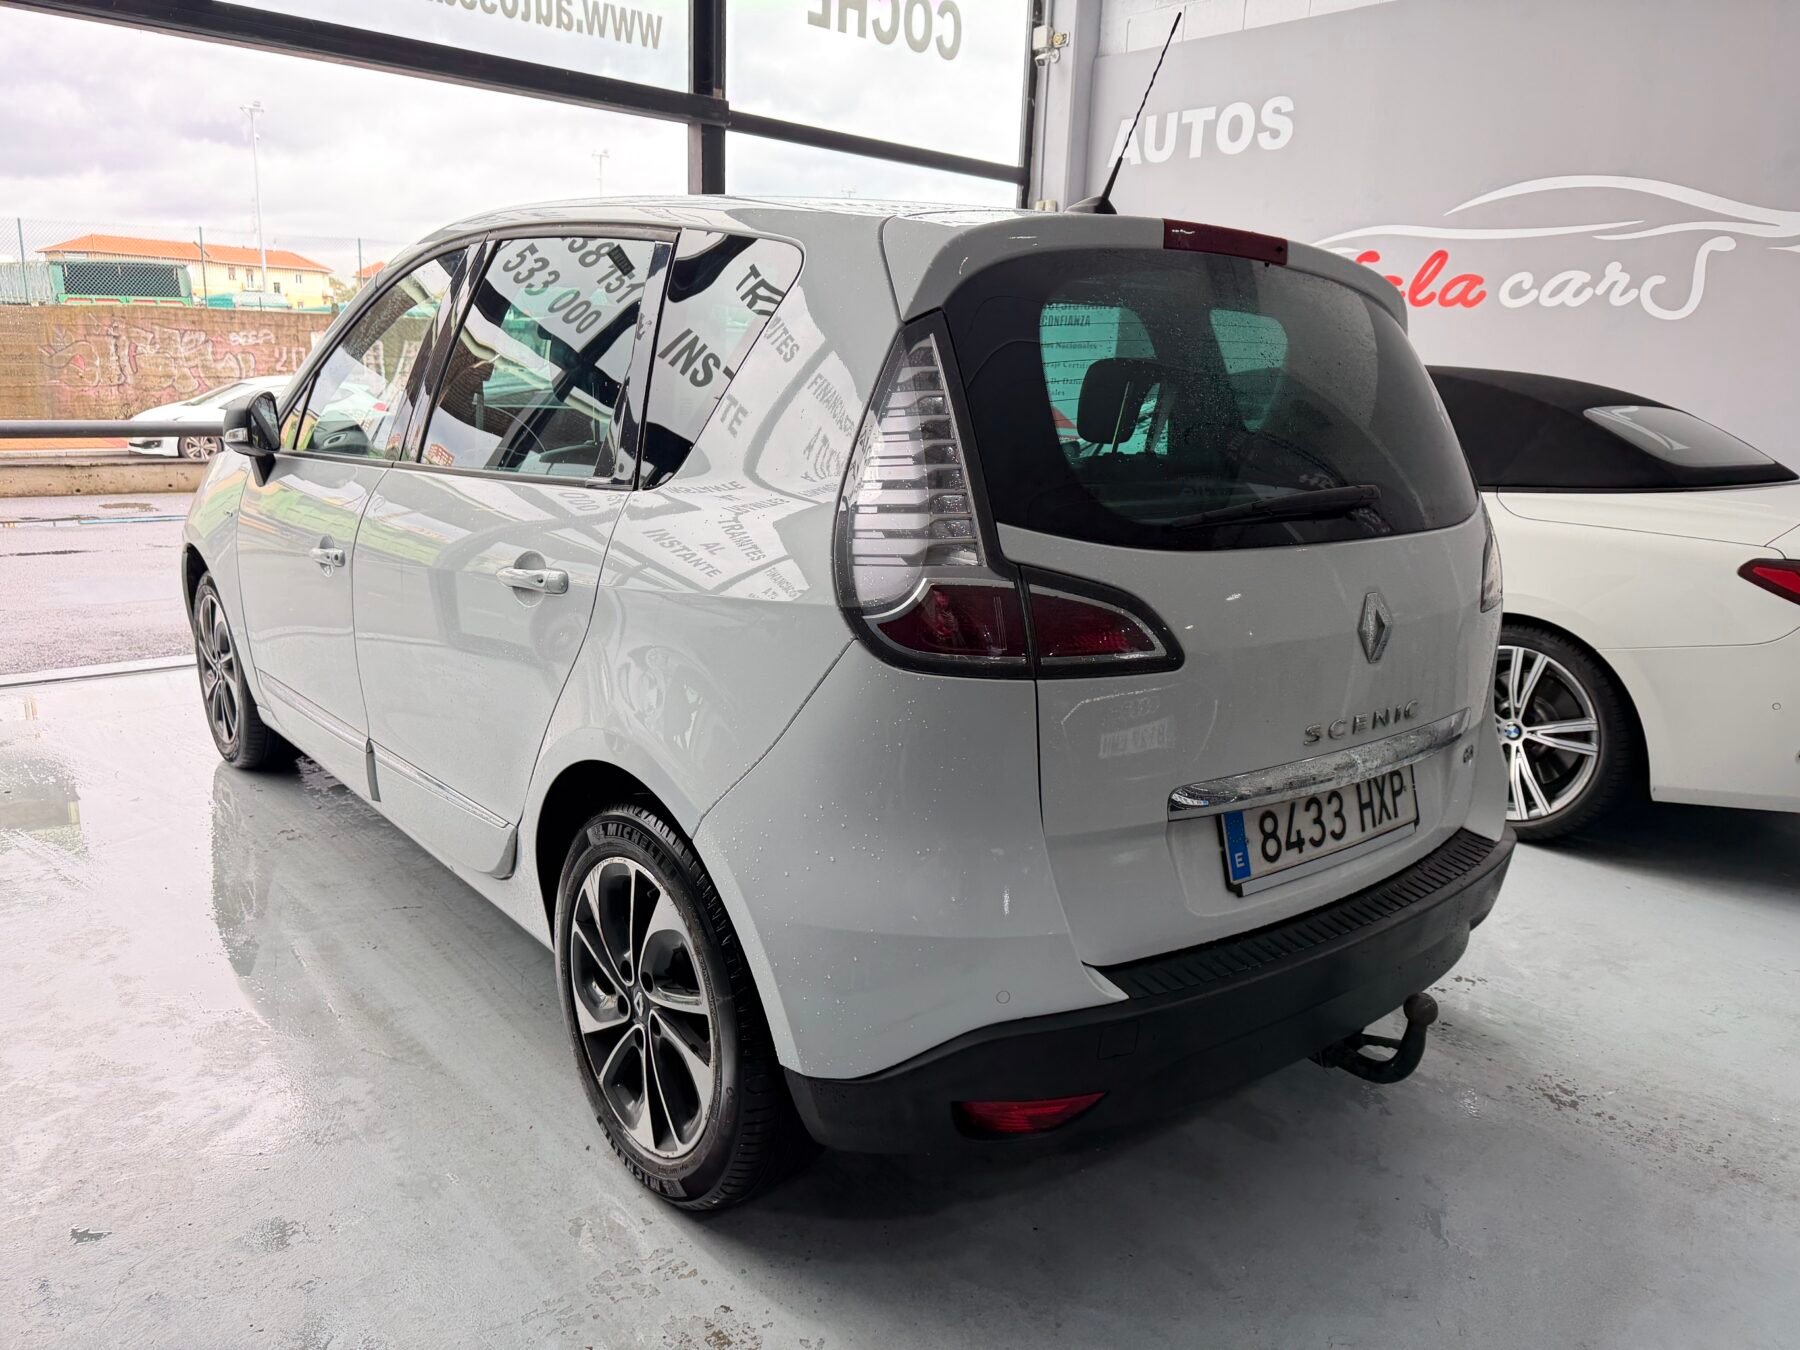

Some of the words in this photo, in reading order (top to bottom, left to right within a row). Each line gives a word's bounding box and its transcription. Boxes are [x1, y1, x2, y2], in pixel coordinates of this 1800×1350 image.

[1107, 95, 1295, 168] AUTOS
[502, 243, 561, 296] 533
[547, 288, 602, 335] 000
[1355, 249, 1488, 309] la
[1043, 315, 1091, 327] CONFIANZA
[657, 327, 736, 388] INS
[641, 528, 722, 578] INSTANTE
[1303, 699, 1419, 746] SCENIC
[1258, 789, 1347, 864] 8433
[1355, 769, 1404, 833] HXP
[606, 822, 676, 875] MICHELIN
[1234, 851, 1245, 868] E
